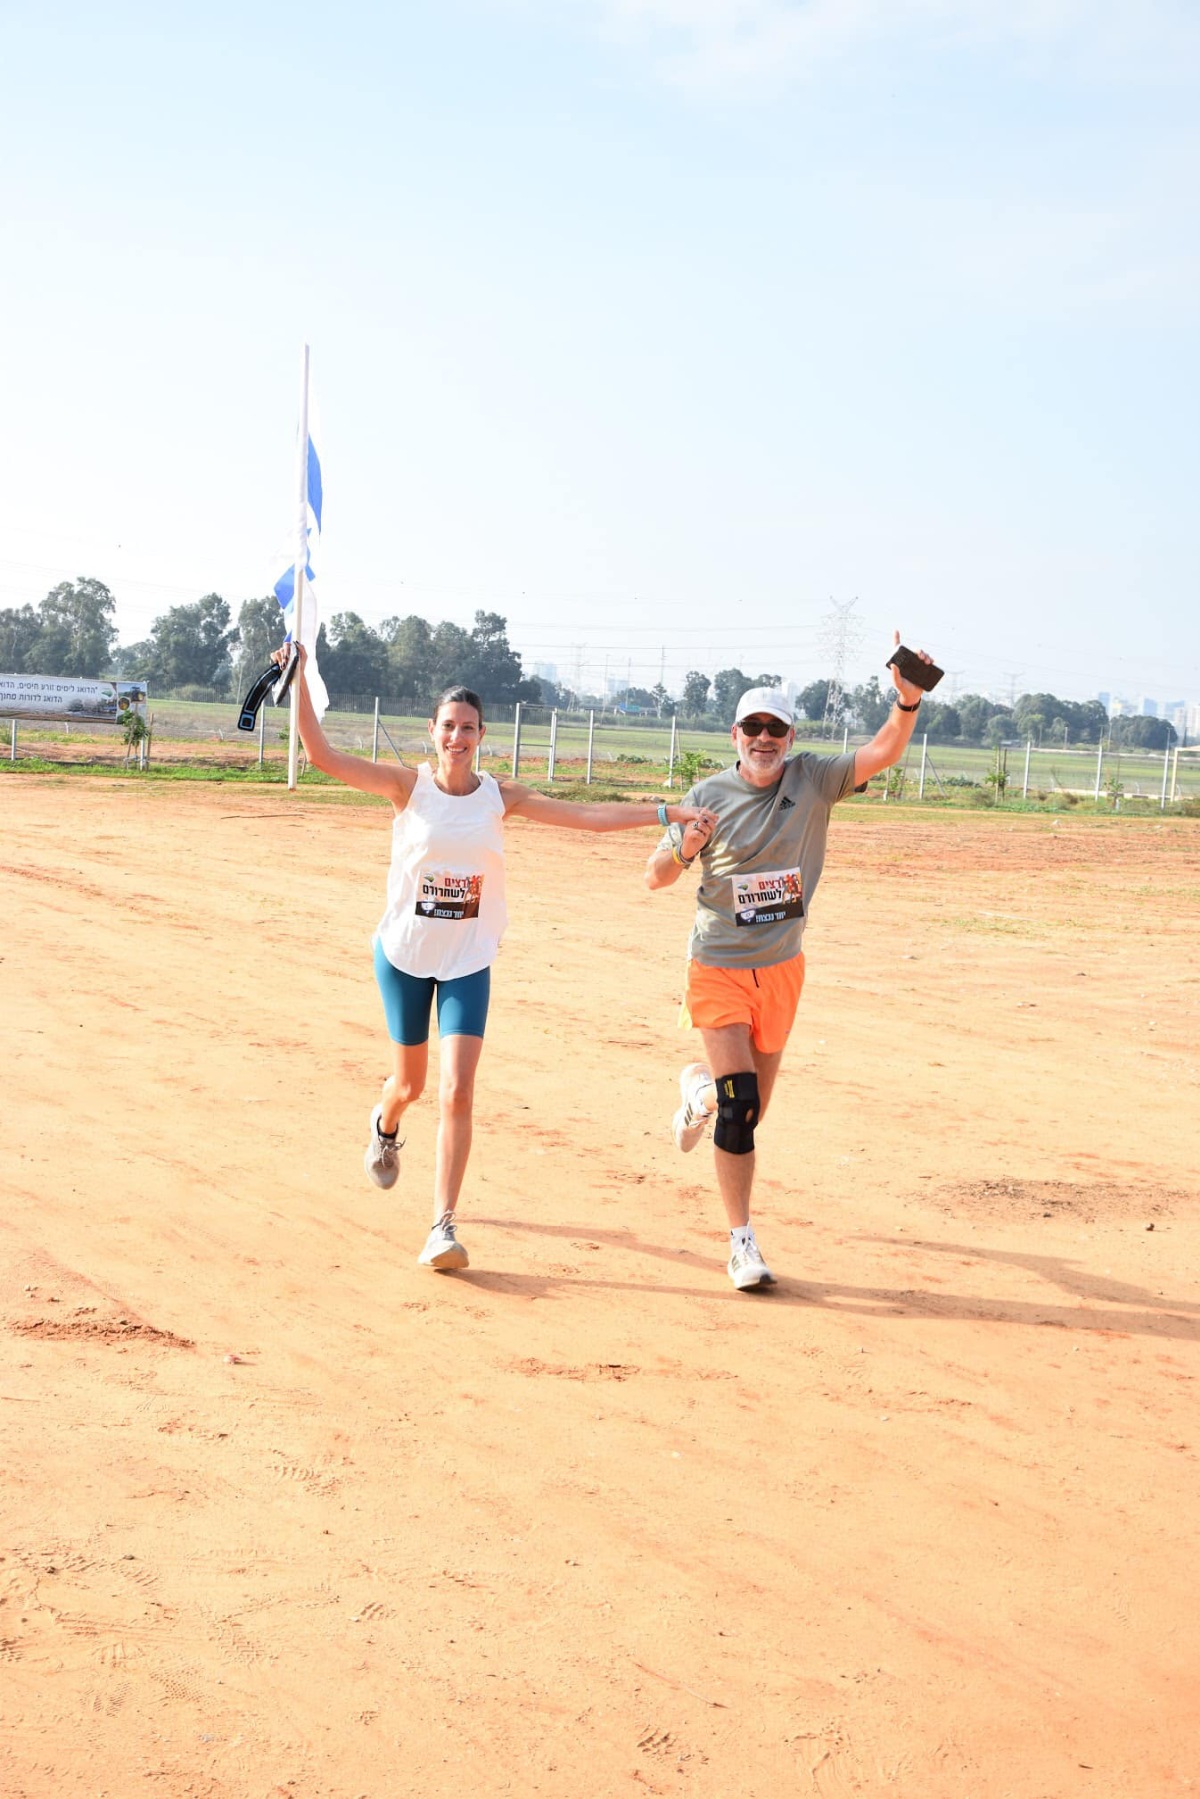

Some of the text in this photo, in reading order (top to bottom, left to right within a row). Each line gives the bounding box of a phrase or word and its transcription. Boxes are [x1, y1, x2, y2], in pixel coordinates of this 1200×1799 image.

[445, 877, 466, 888] רצים
[758, 880, 782, 890] רצים
[422, 884, 465, 898] לשחרורם
[738, 888, 782, 904] לשחרורם
